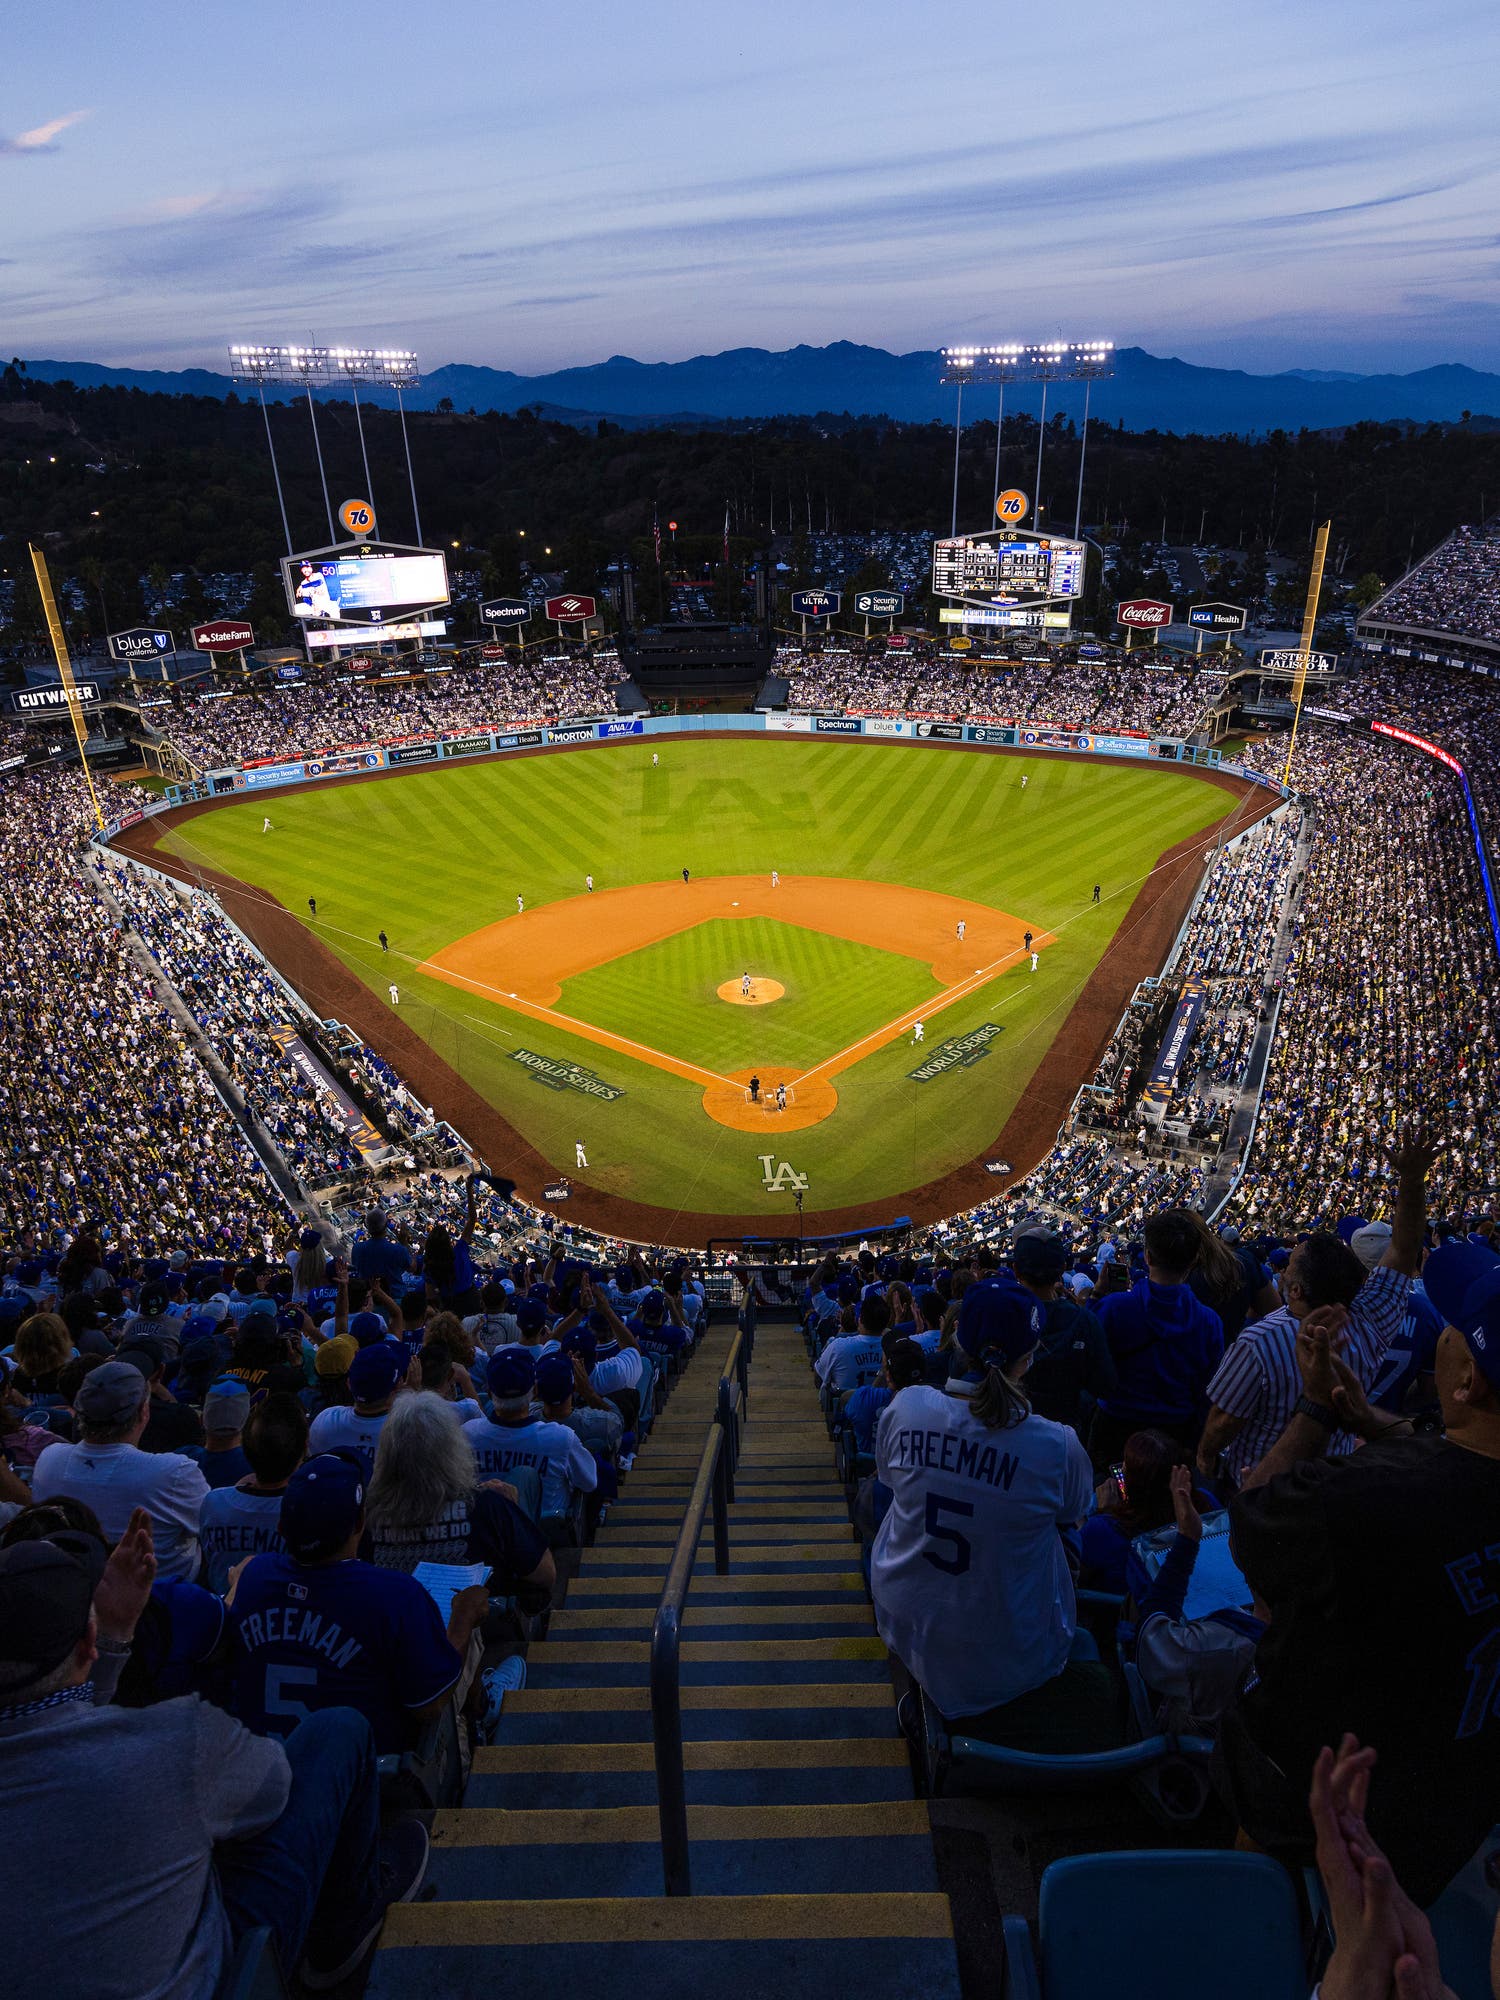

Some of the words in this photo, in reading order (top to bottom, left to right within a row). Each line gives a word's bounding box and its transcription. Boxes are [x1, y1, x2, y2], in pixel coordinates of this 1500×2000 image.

[1003, 498, 1021, 514] 76
[350, 509, 369, 525] 76
[322, 567, 336, 576] 50
[873, 597, 899, 605] Security
[485, 607, 524, 618] Spectrum
[873, 604, 895, 612] Benefit
[1193, 613, 1211, 622] UCLA
[1214, 615, 1240, 624] Health
[117, 636, 152, 651] blue
[125, 648, 158, 657] california
[1267, 660, 1315, 671] JALISCO
[608, 724, 626, 732] ANA
[818, 720, 855, 729] Spectrum
[873, 722, 893, 731] blue
[554, 730, 593, 742] MORTON
[987, 730, 1007, 738] Security
[502, 738, 516, 746] UCLA
[518, 735, 539, 744] Health
[1103, 741, 1126, 751] Security
[1126, 744, 1148, 752] Benefit
[400, 748, 432, 759] vividseats
[256, 772, 281, 782] Security
[280, 768, 301, 778] Benefit
[912, 1050, 963, 1080] WORLD
[957, 1025, 1001, 1052] SERIES
[514, 1050, 568, 1077] WORLD
[563, 1073, 620, 1100] SERIES
[758, 1154, 809, 1192] LA
[131, 1323, 162, 1335] JUDGE
[899, 1430, 1020, 1491] FREEMAN
[425, 1524, 449, 1539] WE
[450, 1522, 472, 1537] DO
[923, 1492, 974, 1577] 5
[206, 1526, 287, 1554] FREEMA
[239, 1607, 364, 1670] FREEMAN
[265, 1663, 319, 1748] 5
